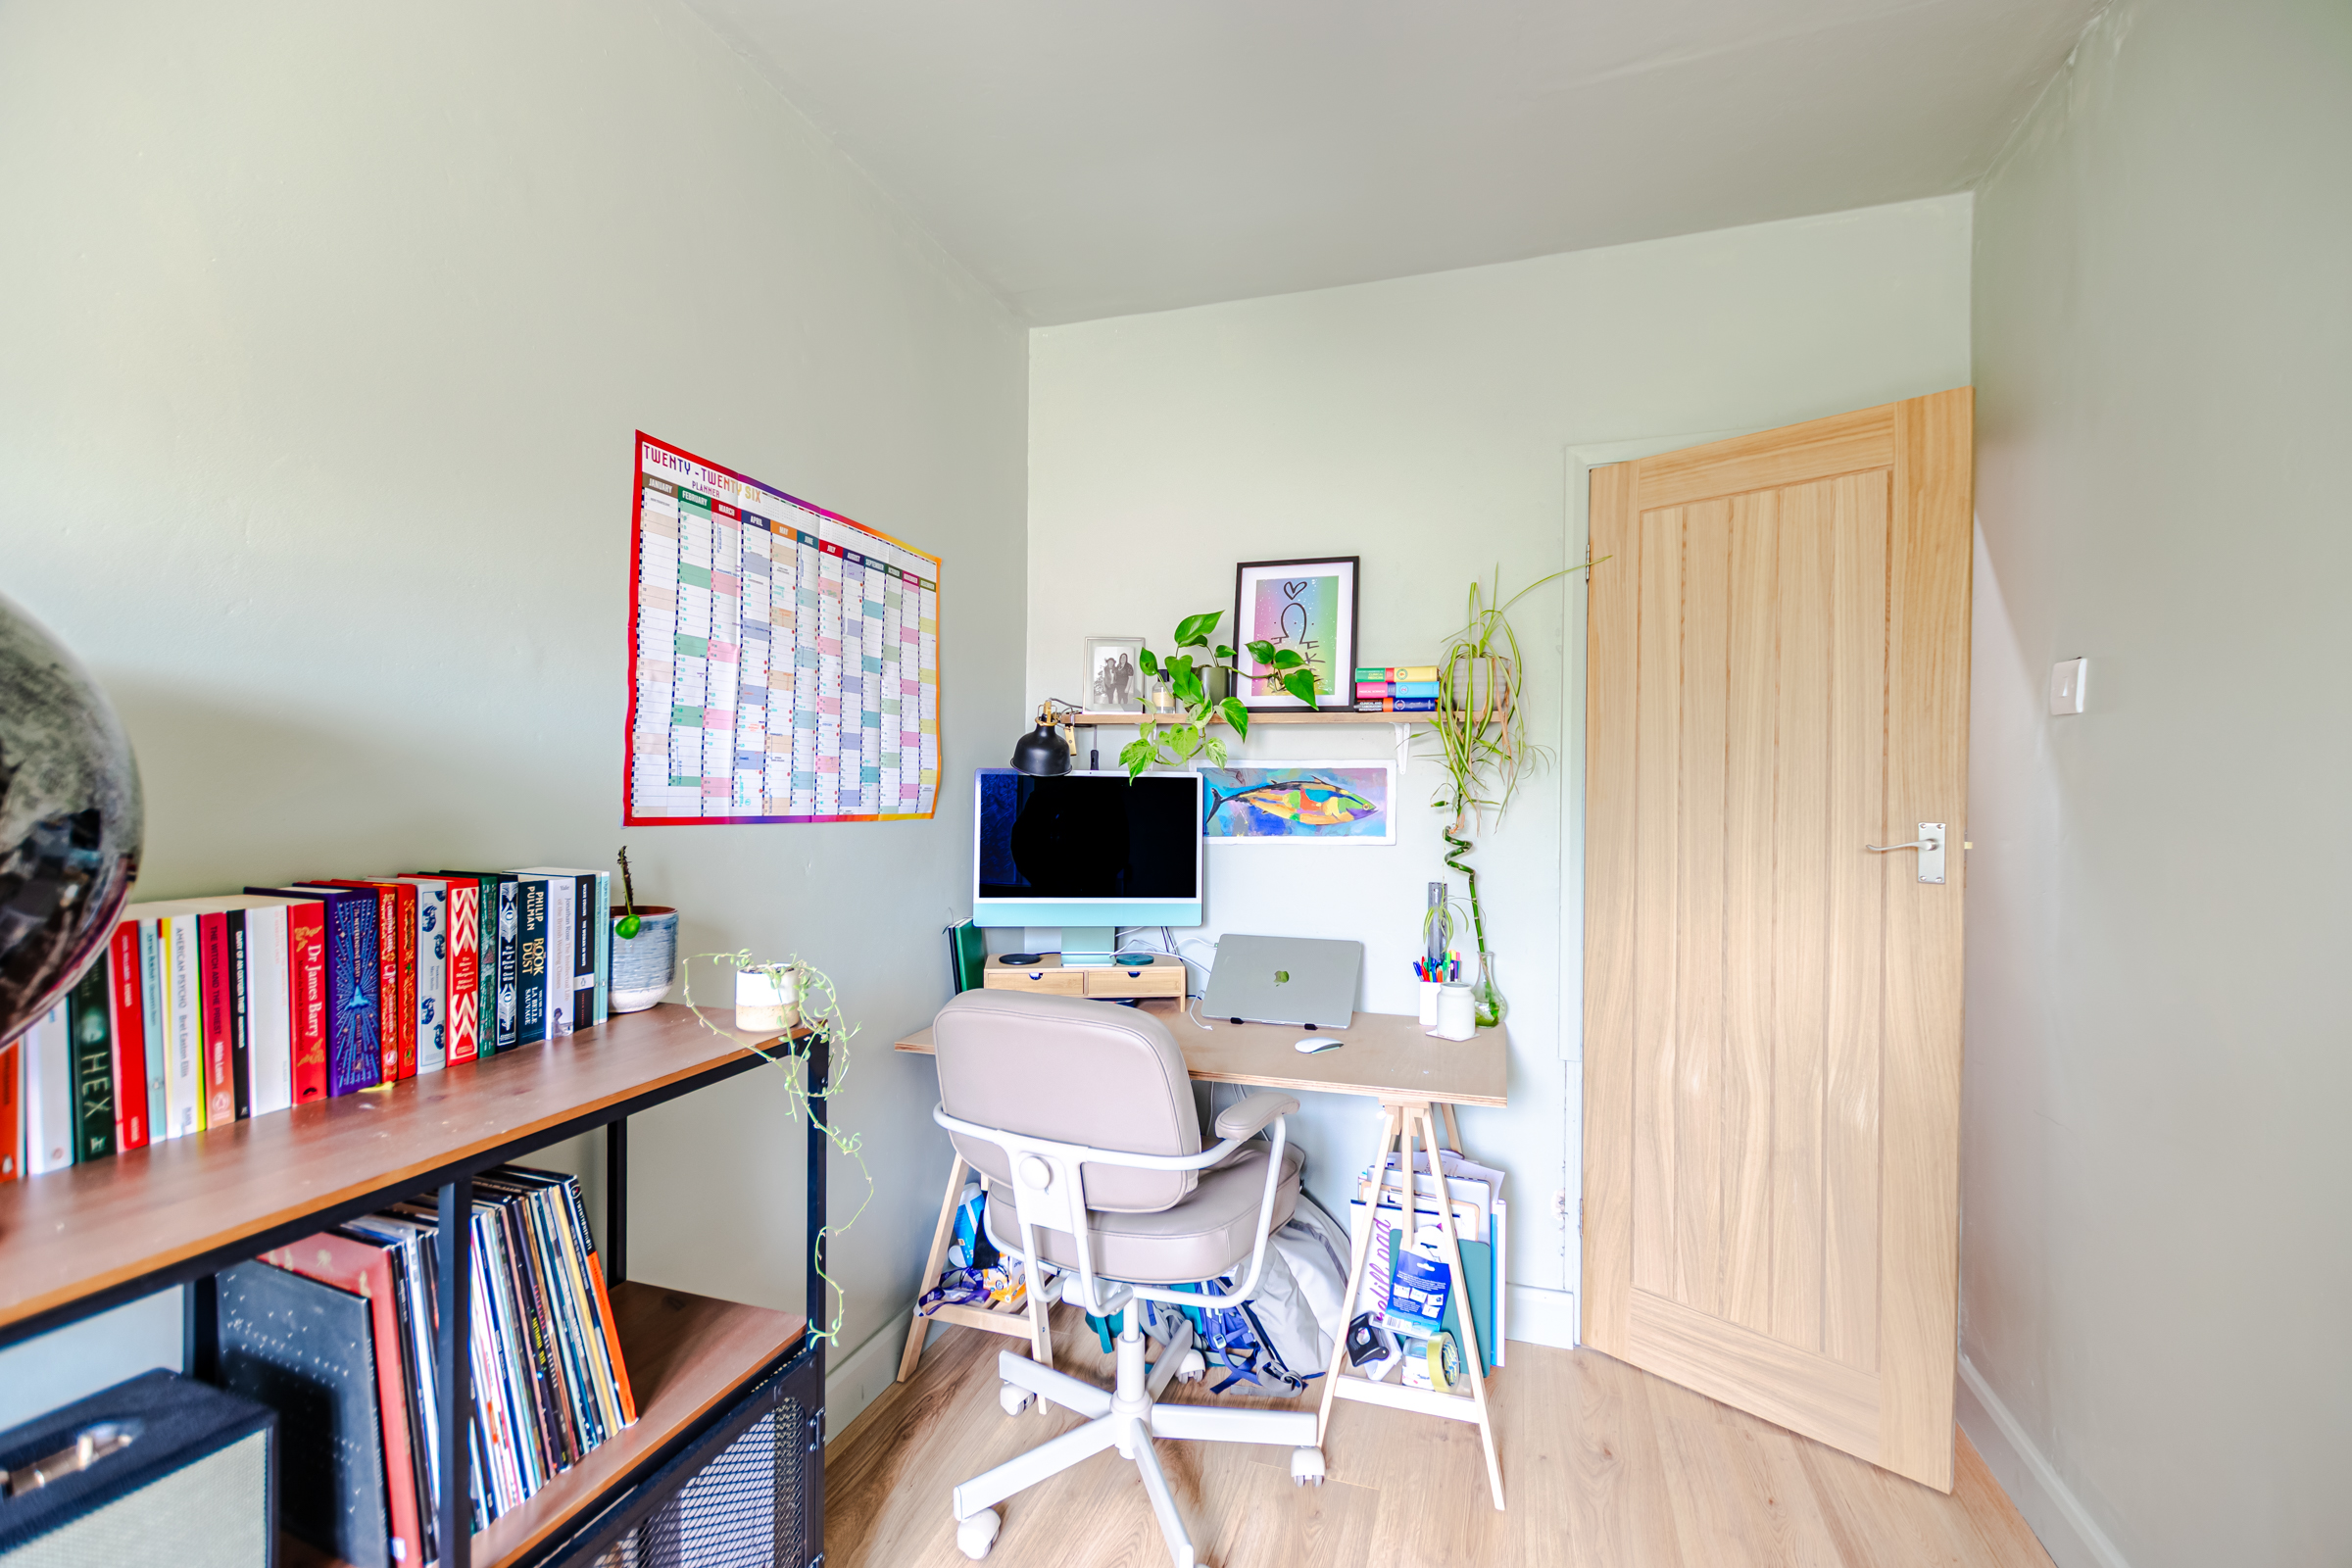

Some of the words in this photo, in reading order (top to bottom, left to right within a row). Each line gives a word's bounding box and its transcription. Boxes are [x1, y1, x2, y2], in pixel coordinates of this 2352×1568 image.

[644, 444, 690, 475] TWENTY
[745, 485, 761, 504] SIX
[649, 478, 673, 493] JANUARY
[682, 490, 708, 506] FEBRUARY
[692, 481, 720, 498] PLANNER
[718, 504, 735, 516] MARCH
[750, 515, 763, 527] APRIL
[779, 526, 788, 536] MAY
[827, 544, 836, 553] JULY
[527, 886, 535, 931] PULLMAN
[535, 891, 544, 922] PHILIP
[563, 897, 572, 926] Jonathan
[176, 928, 187, 971] AMERICAN
[211, 943, 219, 969] WITCH
[236, 950, 244, 959] OF
[308, 944, 321, 962] Dr
[522, 942, 533, 974] DUST
[533, 938, 544, 976] BOOK
[236, 960, 244, 970] AN
[178, 975, 188, 1008] PSYCHO
[237, 970, 245, 996] OXYGEN
[305, 965, 322, 1001] James
[532, 986, 538, 997] LA
[179, 1015, 189, 1032] Bret
[213, 1007, 222, 1035] PRIEST
[305, 1002, 322, 1037] Barry
[180, 1033, 190, 1059] Easton
[181, 1060, 191, 1078] Ellis
[81, 1052, 112, 1119] HEX
[1373, 1217, 1391, 1264] pad
